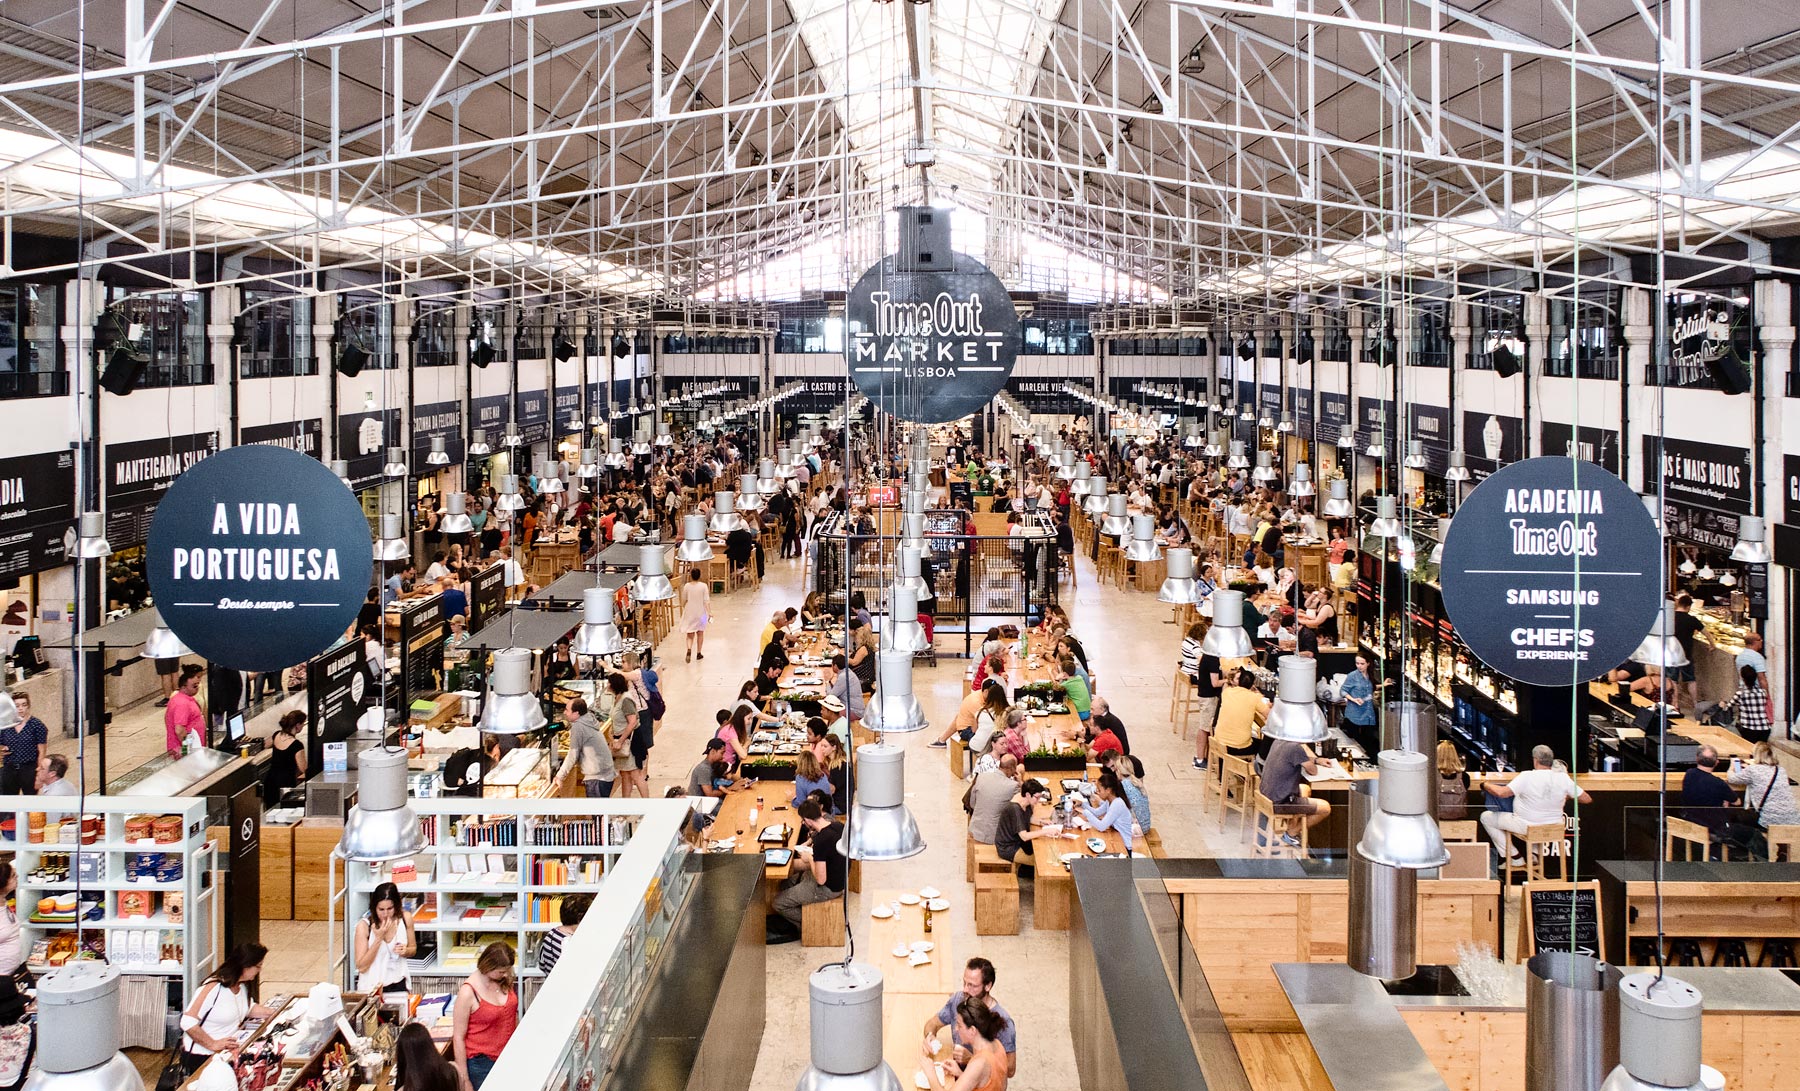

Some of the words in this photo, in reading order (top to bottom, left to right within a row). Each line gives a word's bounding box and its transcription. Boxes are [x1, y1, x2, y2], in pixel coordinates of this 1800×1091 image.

[870, 291, 933, 337] Time
[934, 291, 983, 337] Out
[855, 342, 1004, 362] MARKET
[904, 366, 956, 378] LISBOA
[811, 382, 836, 392] CASTRO
[1018, 382, 1050, 392] MARLENE
[116, 454, 181, 485] MANTEIGARIA
[1675, 453, 1681, 478] É
[1683, 458, 1706, 483] MAIS
[1709, 462, 1740, 489] BOLOS
[0, 478, 24, 506] DIA
[1504, 488, 1603, 514] ACADEMIA
[212, 503, 229, 534] A
[239, 503, 301, 534] VIDA
[1510, 518, 1558, 556] Time
[1558, 520, 1598, 556] Out
[1692, 528, 1734, 550] PAVLOVA
[173, 548, 340, 581] PORTUGUESA
[217, 598, 254, 610] Desde
[252, 600, 295, 612] sempre
[1506, 589, 1599, 606] SAMSUNG
[1510, 627, 1594, 646] CHEF'S
[1516, 650, 1589, 660] EXPERIENCE
[1543, 839, 1571, 857] BAR
